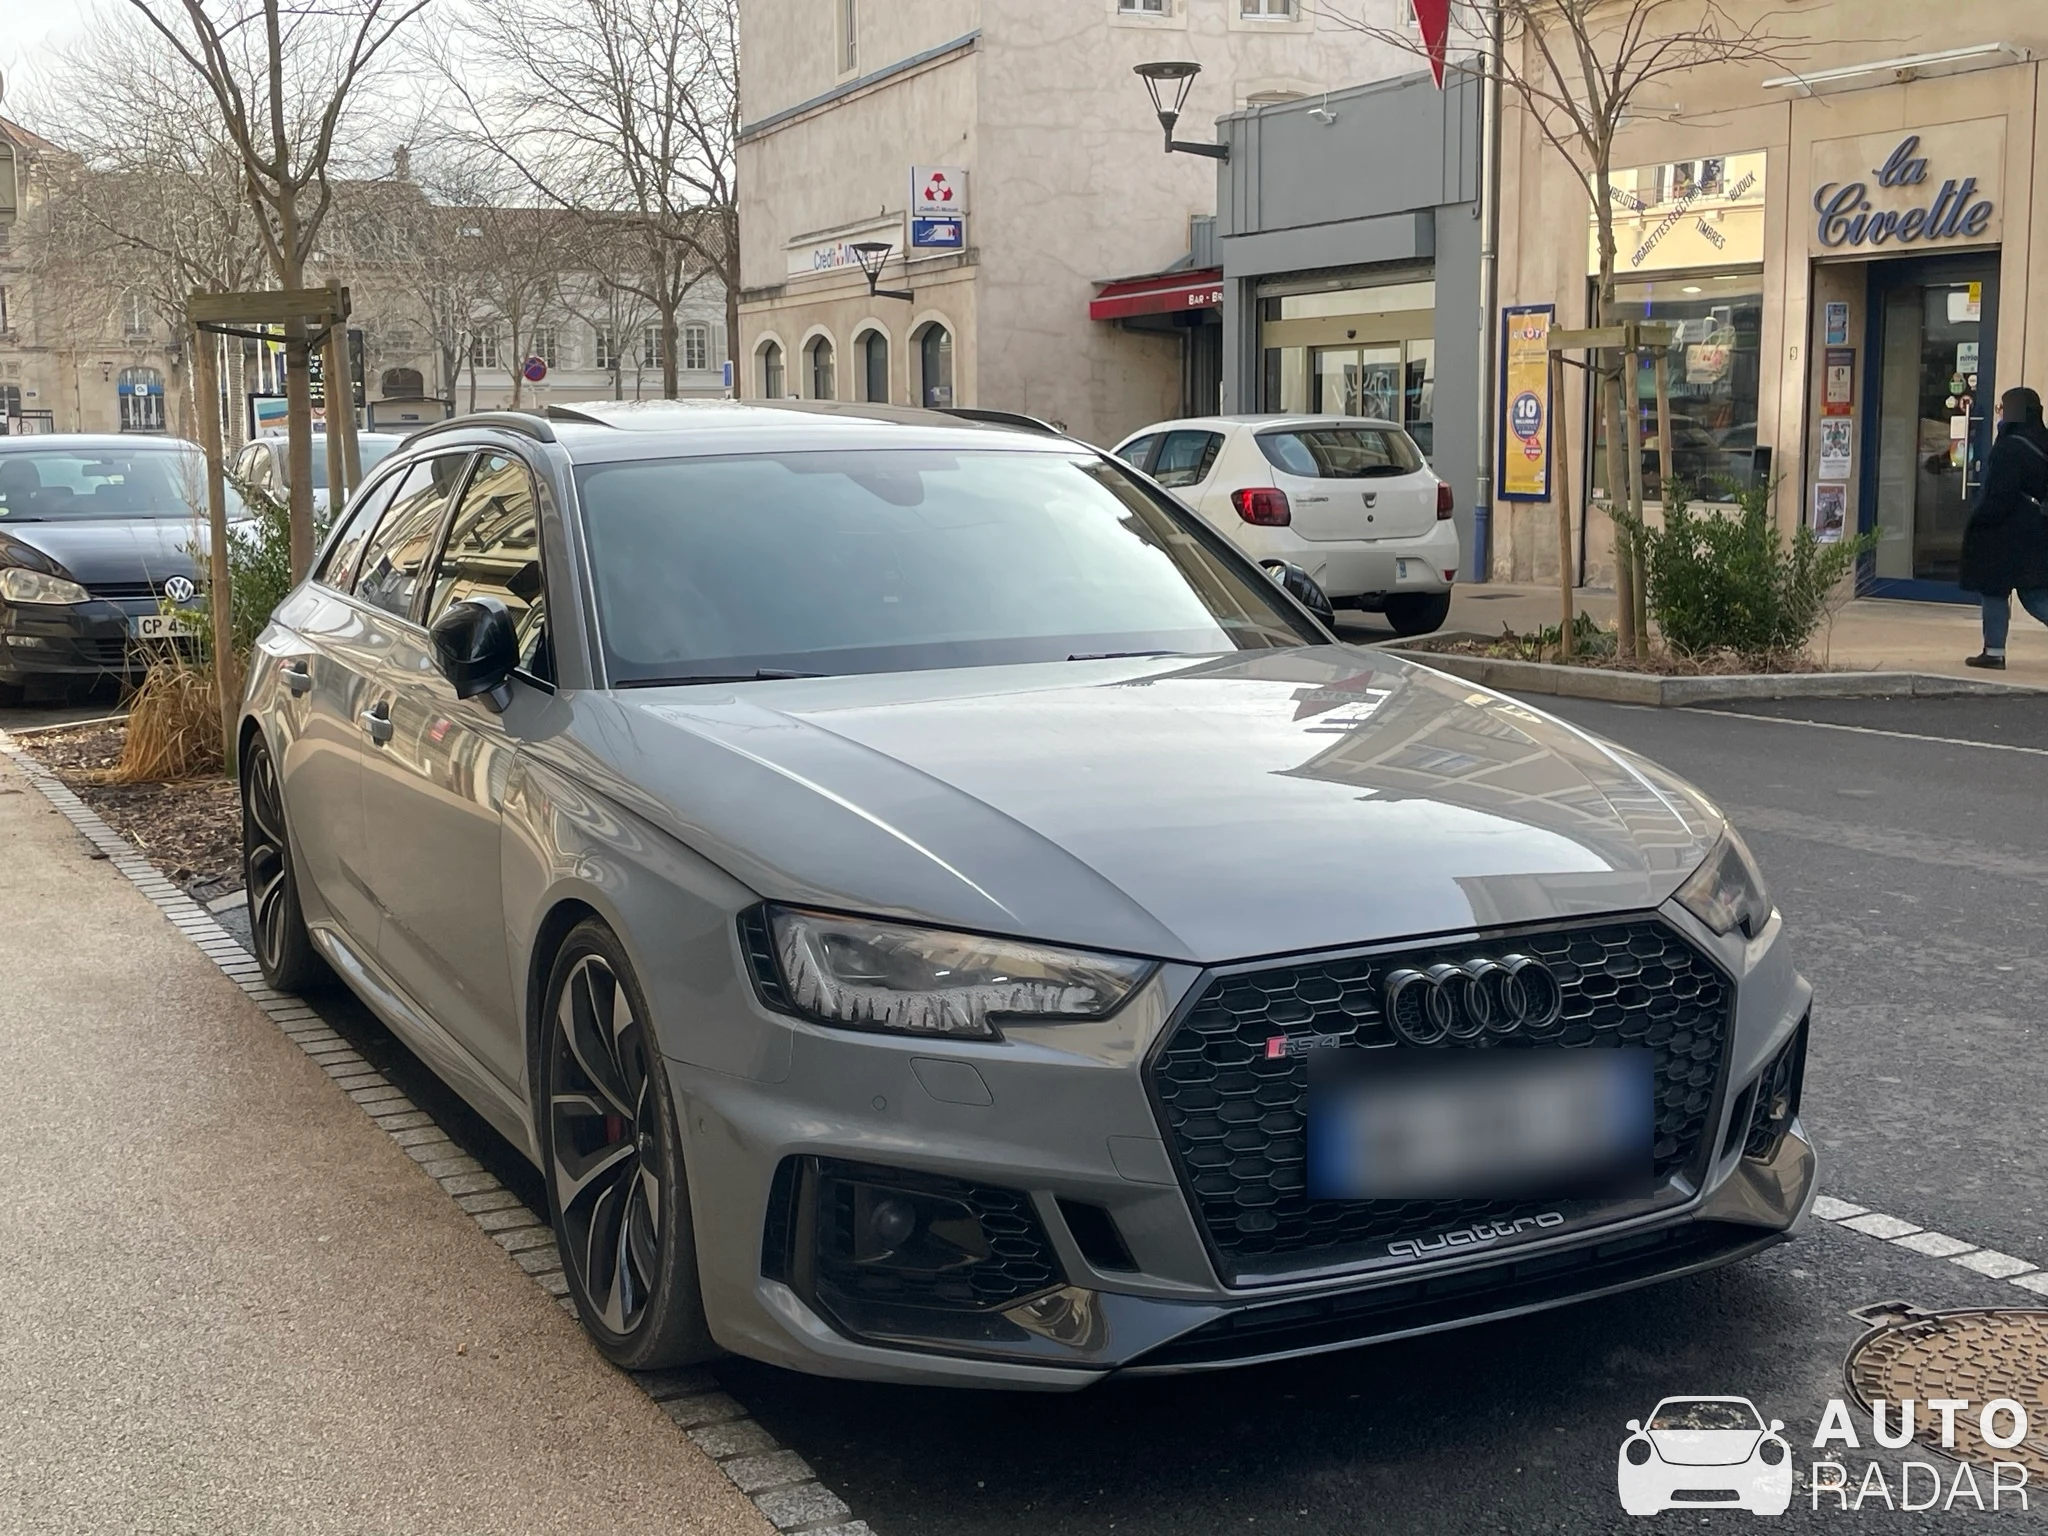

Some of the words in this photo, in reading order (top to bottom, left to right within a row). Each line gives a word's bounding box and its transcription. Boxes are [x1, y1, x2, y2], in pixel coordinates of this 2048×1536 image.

[1872, 135, 1928, 187] la
[1729, 170, 1757, 202] BIJOUX
[1814, 177, 1993, 247] Civette
[1631, 219, 1671, 267] CIGARETTES
[1695, 216, 1726, 250] TIMBRES
[1189, 294, 1204, 305] BAR
[1212, 291, 1224, 302] BR
[1790, 347, 1797, 360] 9
[1518, 399, 1537, 418] 10
[142, 619, 162, 634] CP
[1387, 1211, 1565, 1257] quattro
